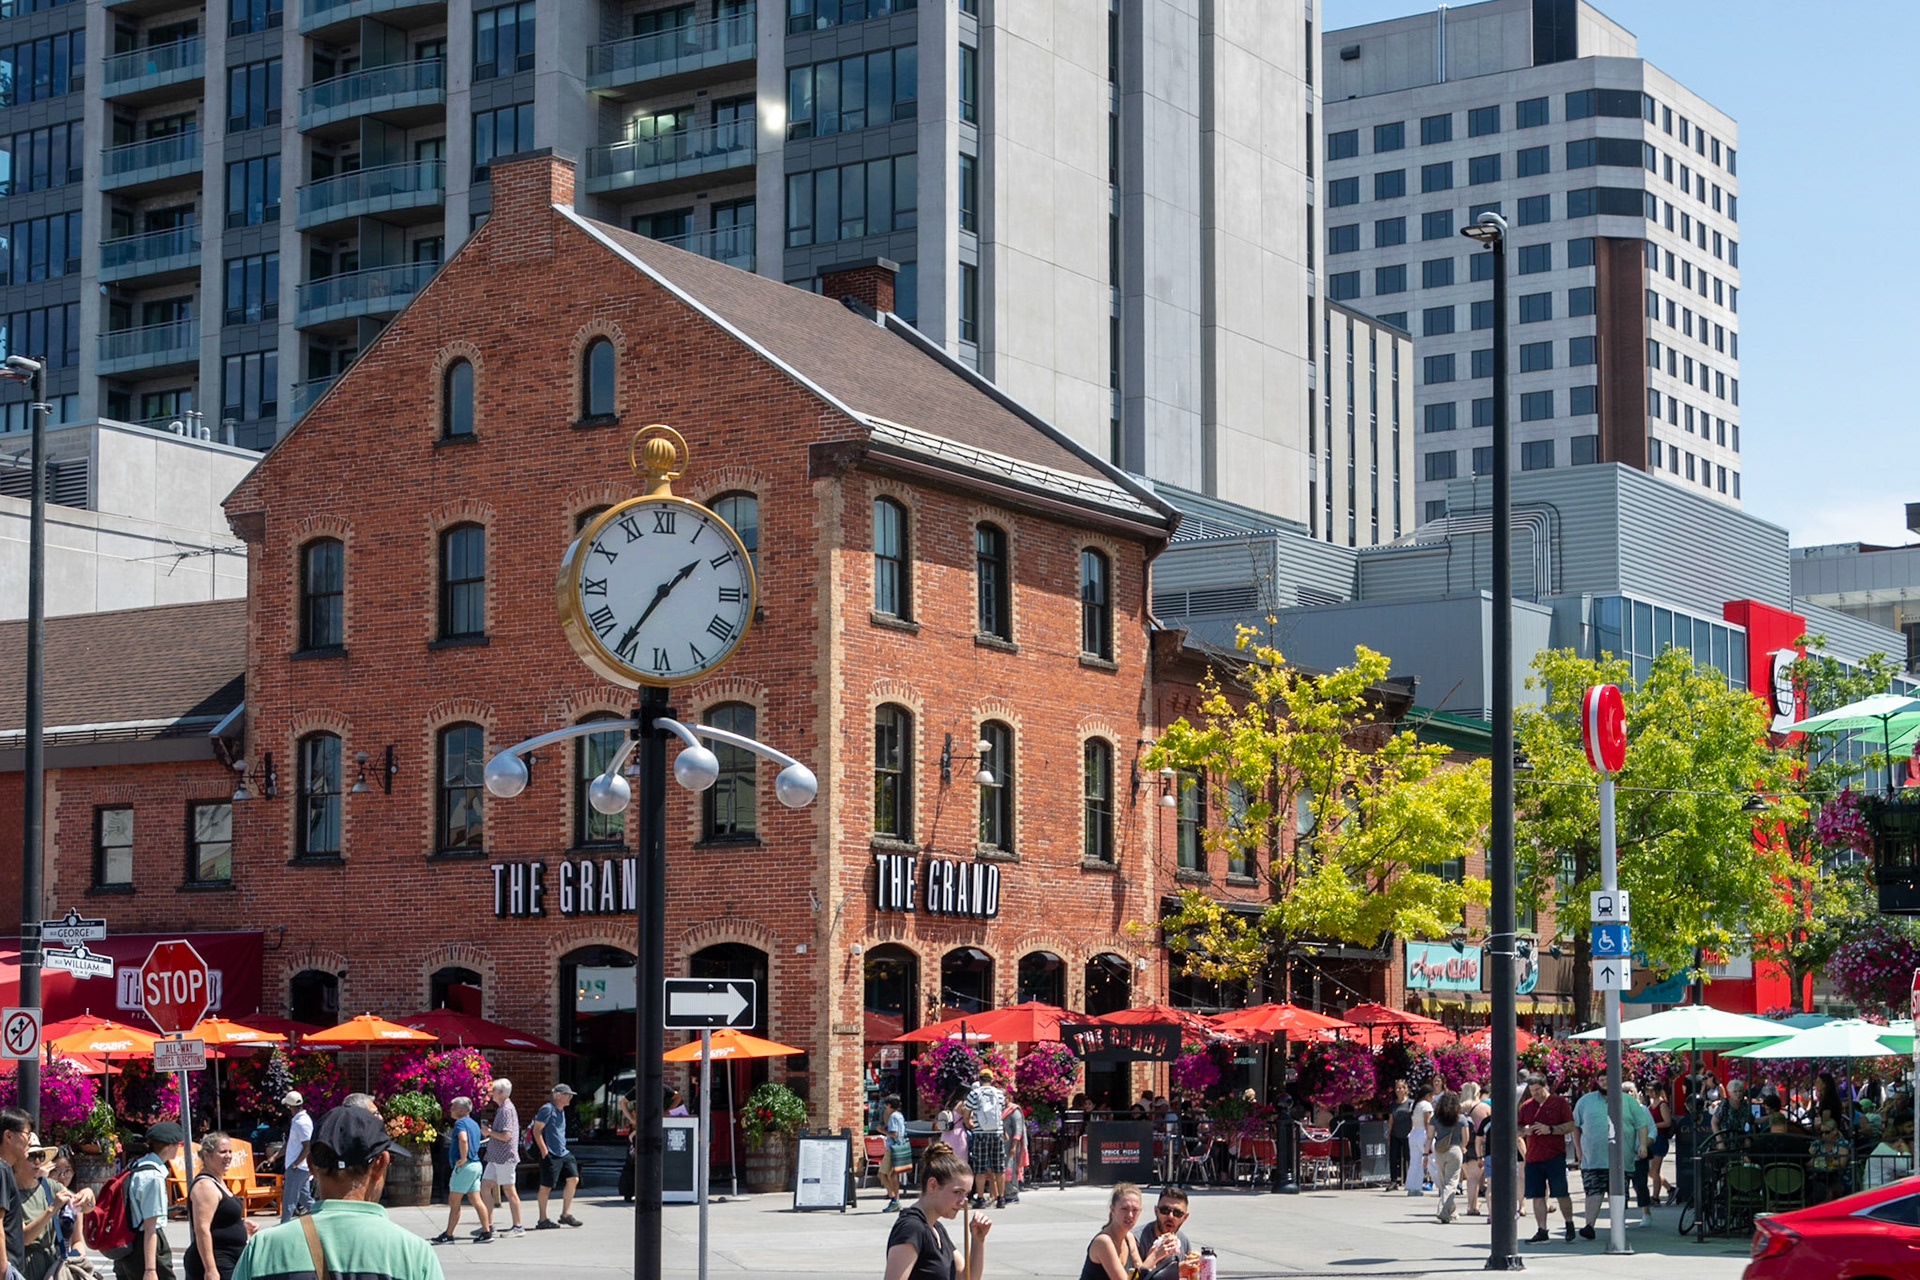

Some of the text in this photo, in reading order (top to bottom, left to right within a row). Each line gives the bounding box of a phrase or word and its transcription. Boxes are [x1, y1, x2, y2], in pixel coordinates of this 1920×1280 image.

[618, 516, 644, 544] XI
[652, 511, 676, 534] XII
[690, 523, 705, 545] I
[594, 542, 618, 565] X
[709, 551, 733, 570] II
[585, 577, 607, 597] IX
[719, 586, 741, 604] III
[589, 604, 618, 639] VIII
[652, 647, 671, 671] VI
[689, 642, 706, 665] V
[491, 858, 637, 914] THE GRAN
[876, 855, 999, 915] THE GRAND
[57, 928, 90, 938] GEORGE
[63, 959, 100, 972] WILLIAM
[146, 969, 203, 1006] STOP
[165, 1042, 193, 1054] ALL-WAY
